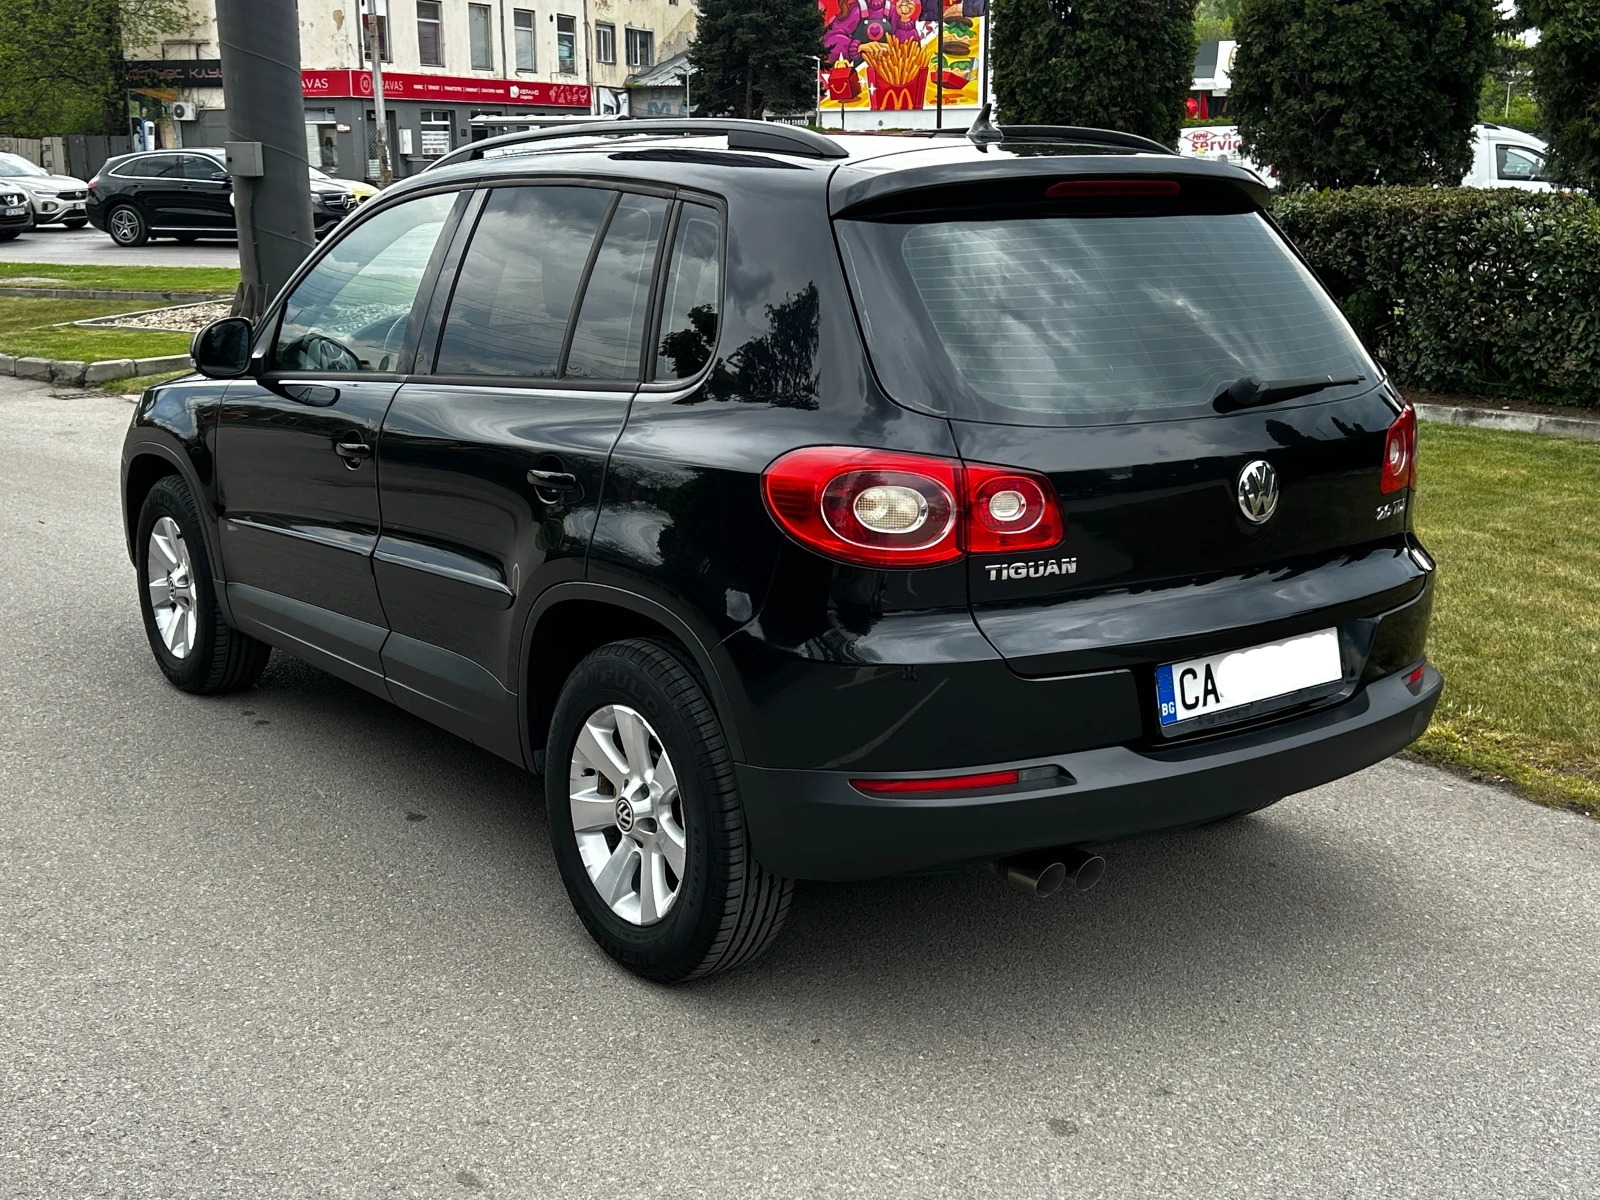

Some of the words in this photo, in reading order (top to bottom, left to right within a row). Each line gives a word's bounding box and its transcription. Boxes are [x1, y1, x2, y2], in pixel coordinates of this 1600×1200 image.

[985, 557, 1077, 581] TIGUAN
[1179, 663, 1220, 711] CA
[1161, 701, 1175, 717] BG
